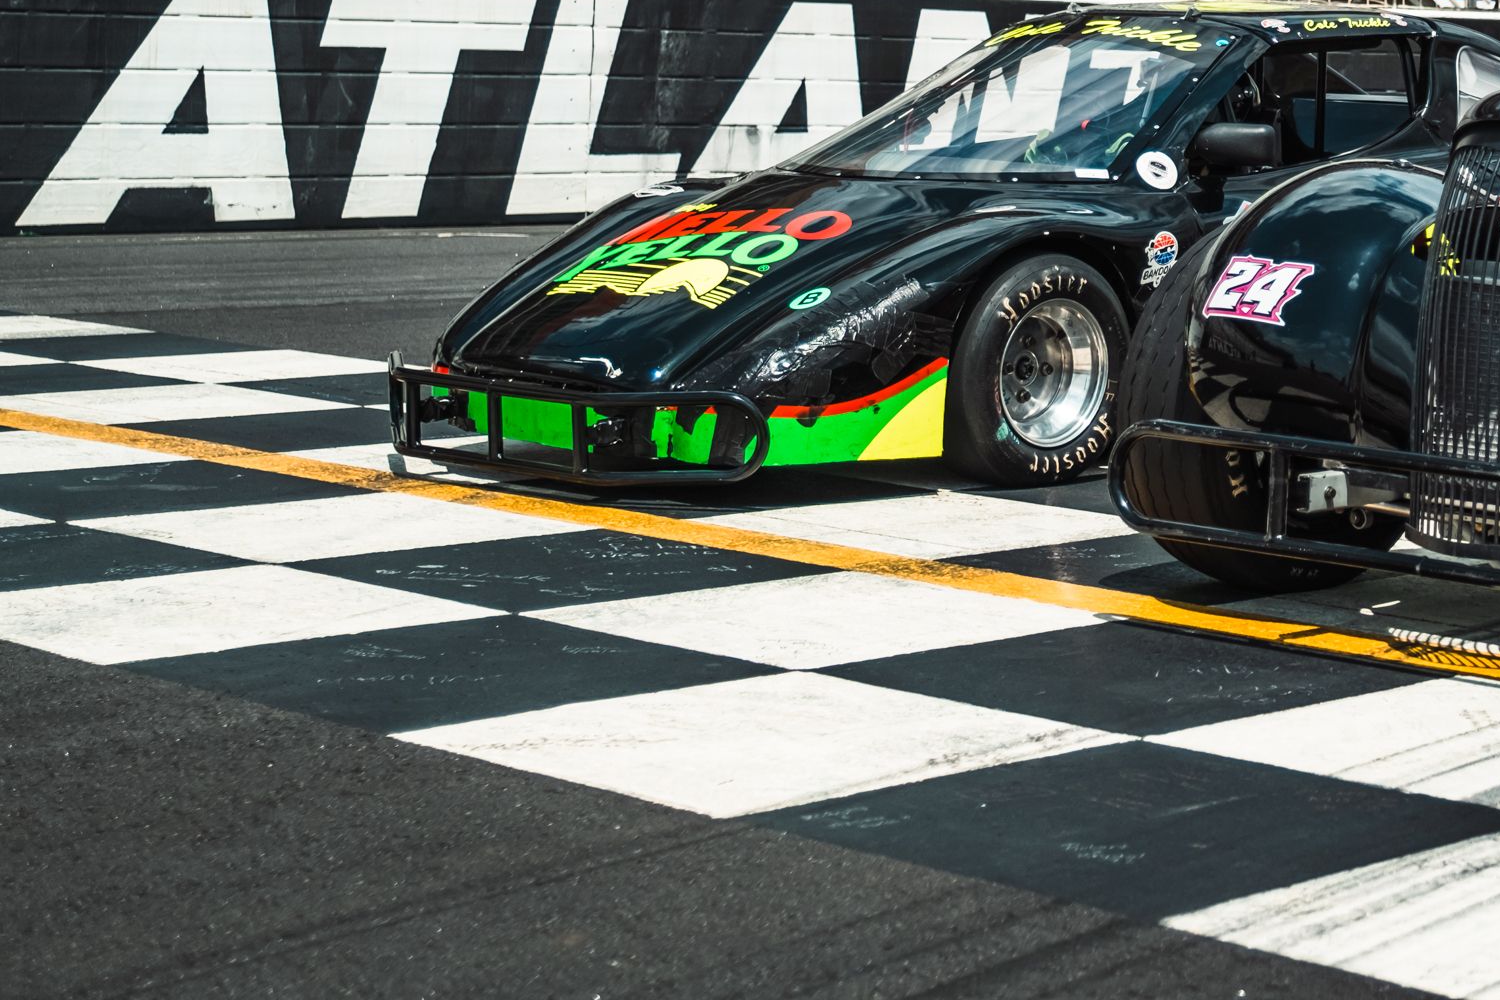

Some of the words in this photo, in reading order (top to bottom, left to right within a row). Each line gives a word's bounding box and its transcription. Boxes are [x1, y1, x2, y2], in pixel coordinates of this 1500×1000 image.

[1303, 19, 1338, 32] Cole
[1338, 17, 1391, 29] Trickle
[553, 231, 799, 283] YELLO
[1205, 259, 1307, 319] 24
